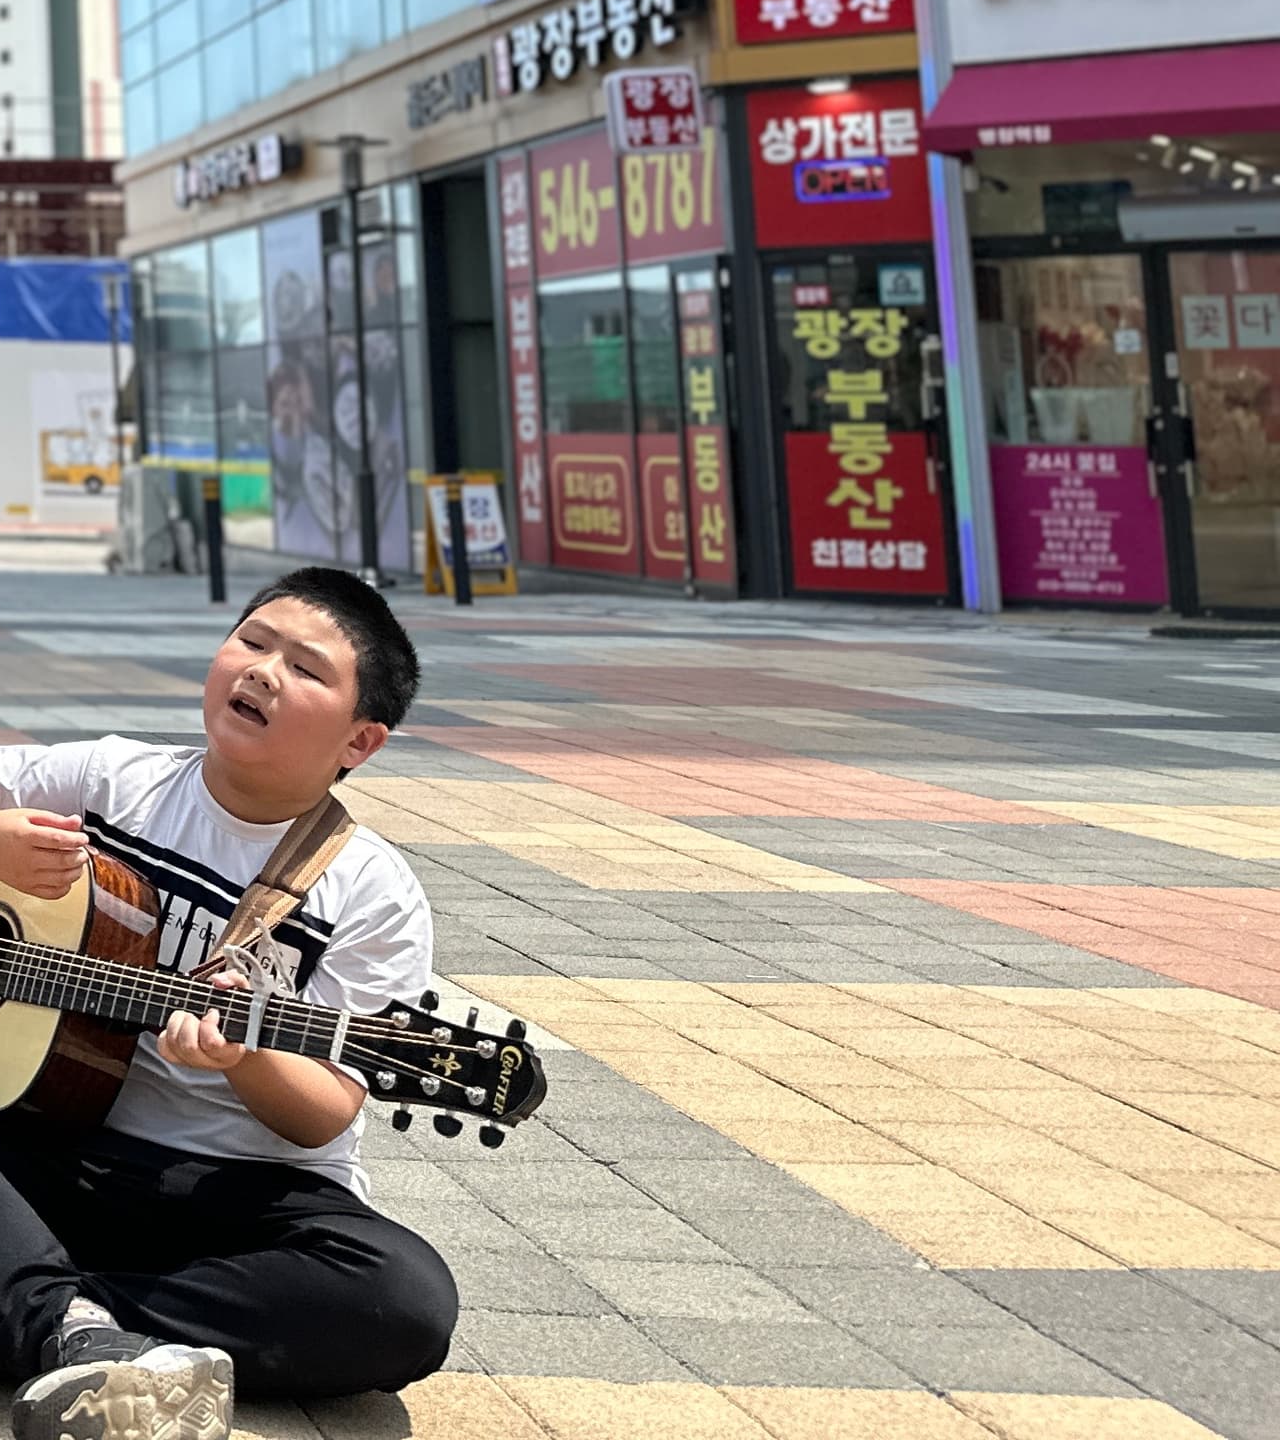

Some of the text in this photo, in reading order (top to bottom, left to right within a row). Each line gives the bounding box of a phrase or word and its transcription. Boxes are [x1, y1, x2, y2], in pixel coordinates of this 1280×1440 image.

[625, 77, 691, 110] 광장
[627, 115, 697, 146] 부동산
[759, 109, 919, 164] 상가전문
[793, 308, 908, 359] 광장
[511, 296, 543, 522] 부동산
[690, 366, 725, 562] 부동산
[824, 370, 904, 529] 부동산
[811, 539, 927, 571] 친절상담
[492, 1045, 523, 1115] CRAFTER
